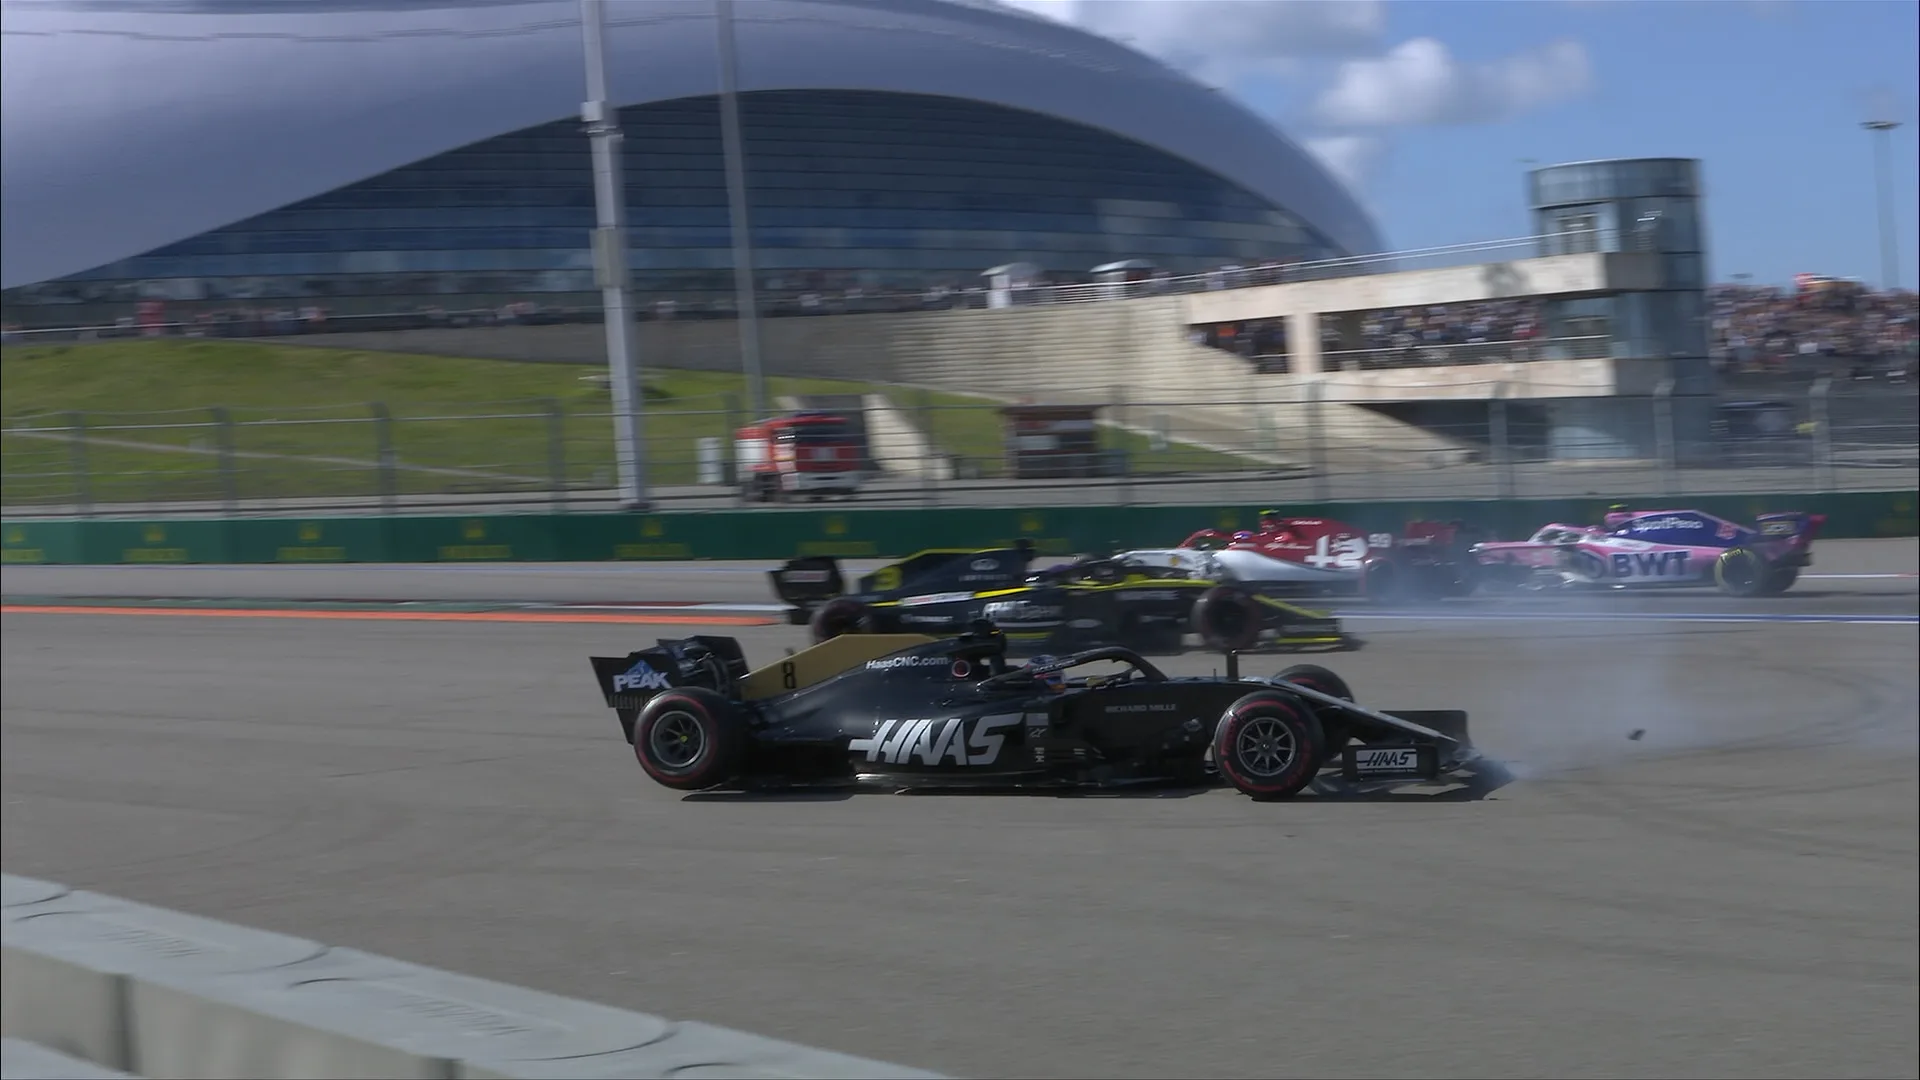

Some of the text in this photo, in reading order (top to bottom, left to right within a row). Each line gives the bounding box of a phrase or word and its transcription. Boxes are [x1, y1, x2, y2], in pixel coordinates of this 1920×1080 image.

[1368, 533, 1392, 548] 99
[1613, 551, 1690, 578] BWT
[866, 656, 949, 670] HaasCNC.com
[613, 671, 673, 693] PEAK
[781, 662, 796, 690] 8
[849, 713, 1024, 765] HAAS
[1357, 751, 1417, 767] HAAS
